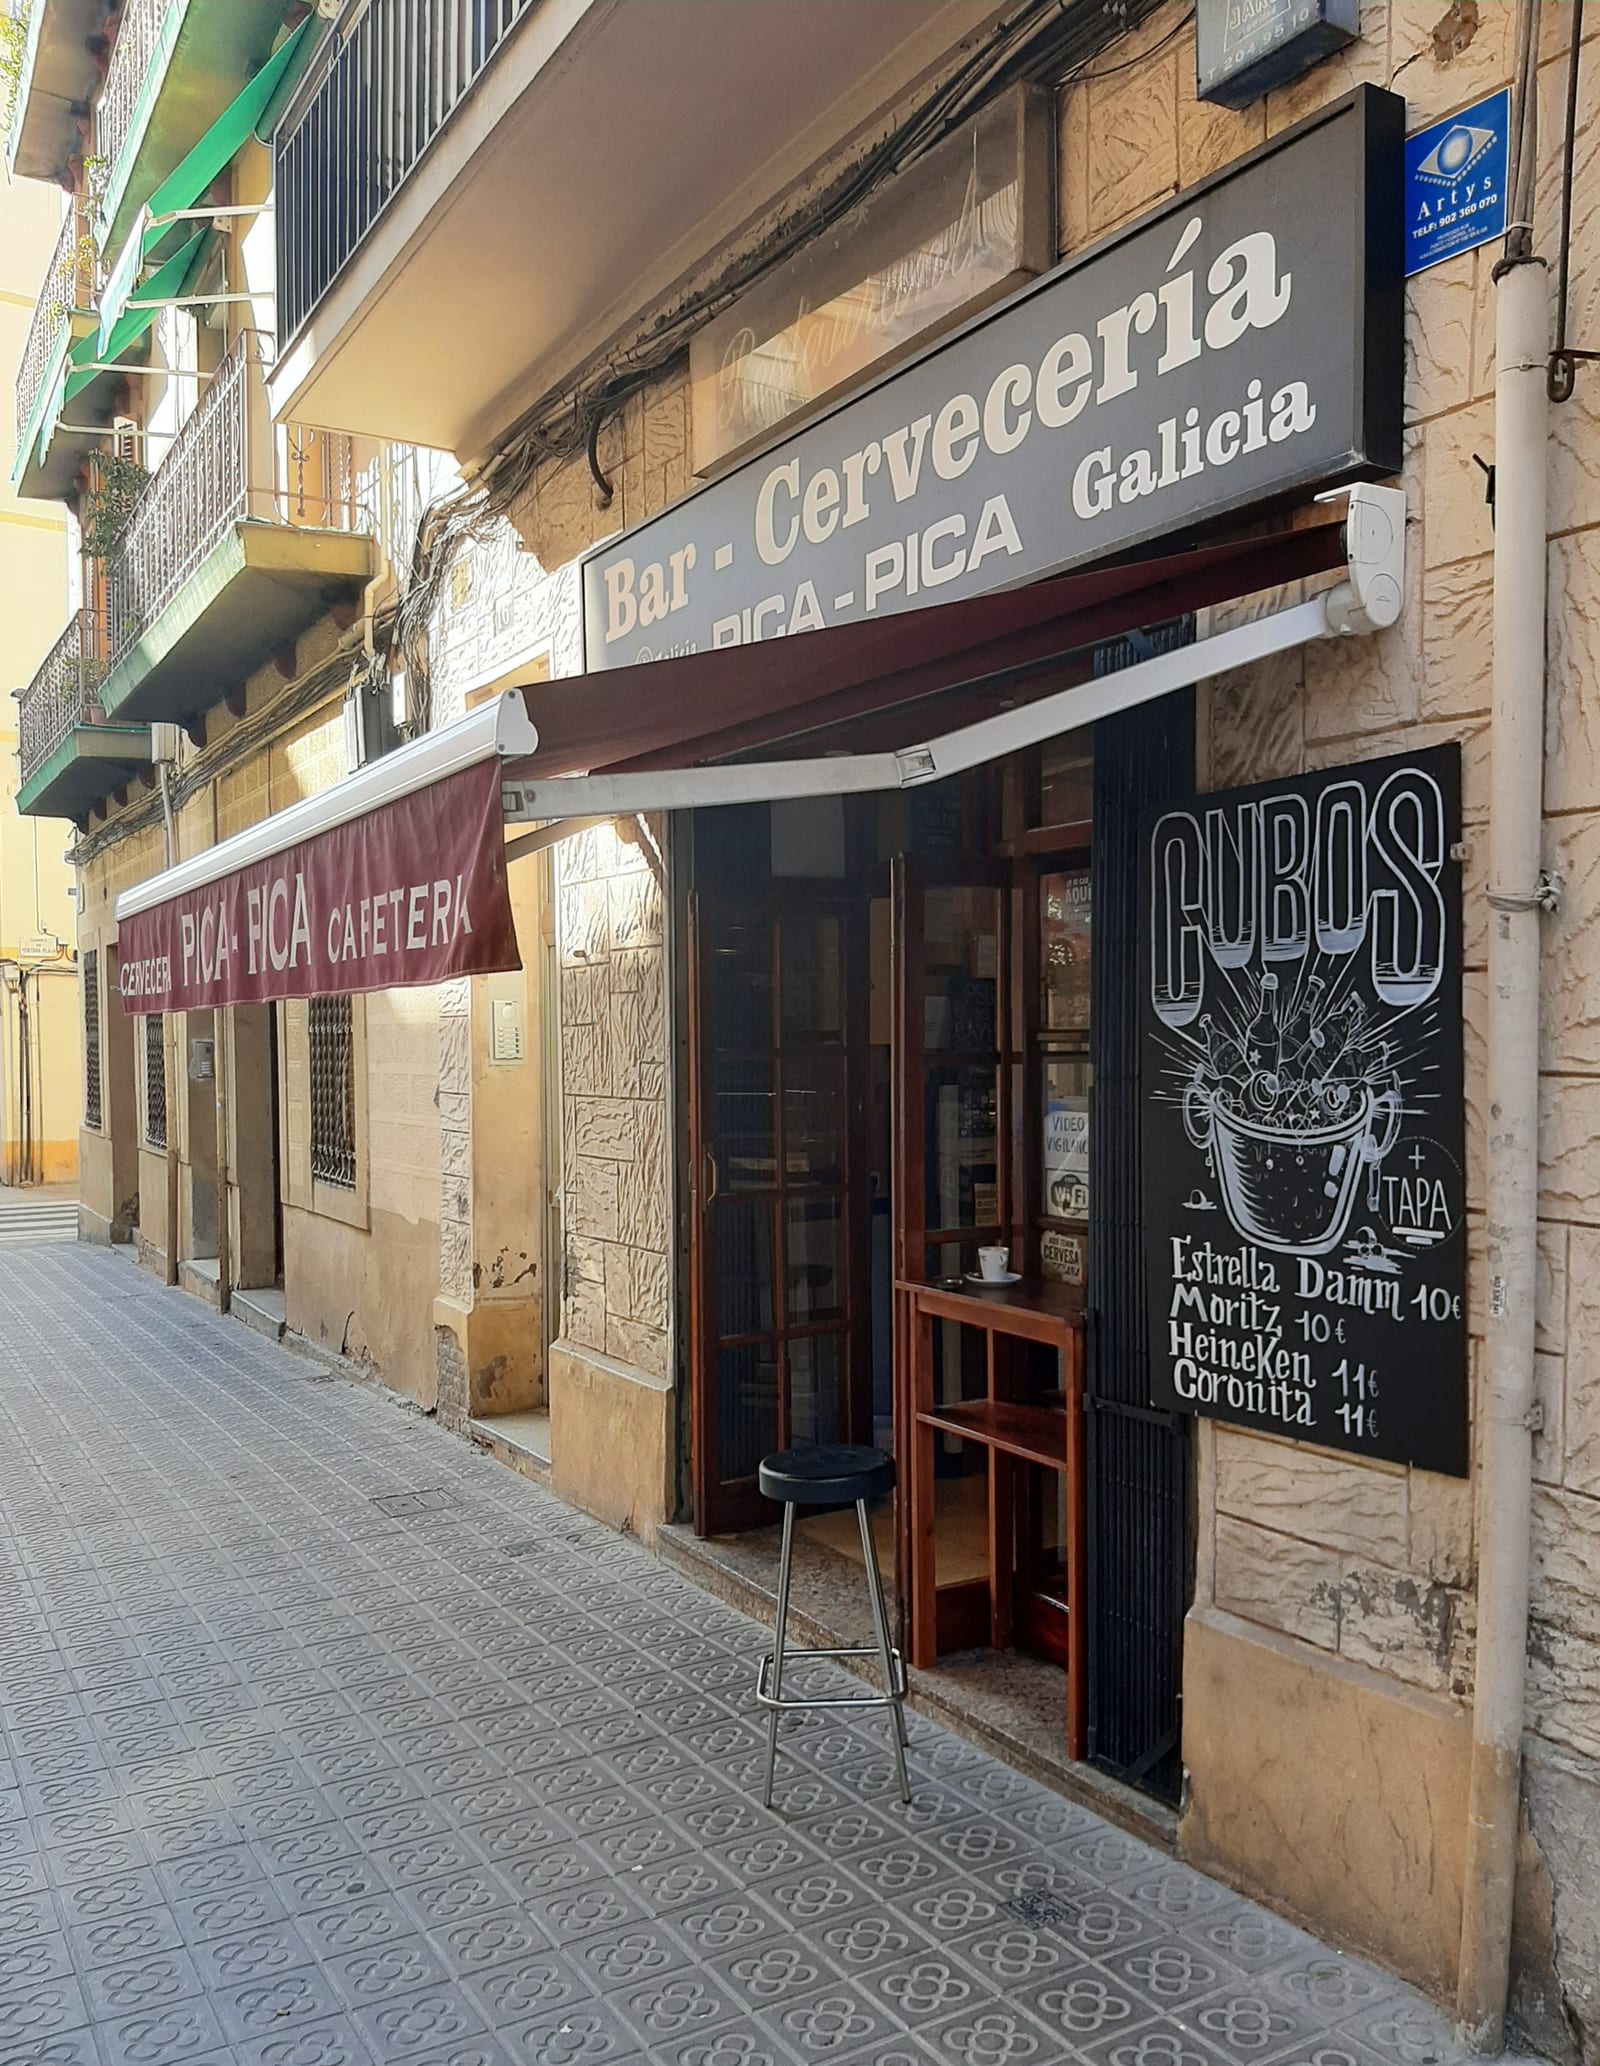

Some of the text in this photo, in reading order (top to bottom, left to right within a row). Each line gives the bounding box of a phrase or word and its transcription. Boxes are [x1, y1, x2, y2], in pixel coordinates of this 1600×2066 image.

[1263, 23, 1285, 45] 95
[1291, 7, 1310, 28] 10
[1417, 176, 1492, 221] Artys
[1439, 212, 1457, 227] 902
[1459, 202, 1477, 218] 360
[1478, 193, 1498, 209] 070
[604, 542, 697, 644] Bar
[754, 217, 1292, 566] Cervecería
[1072, 378, 1317, 520] Galicia
[712, 580, 826, 649] PICA
[866, 494, 1024, 613] PICA
[1151, 768, 1446, 1027] CUBOS
[181, 901, 229, 987] PICA
[247, 873, 311, 975] PICA
[1053, 1116, 1085, 1132] VIDEO
[1382, 1176, 1452, 1230] TAPA
[1044, 1244, 1079, 1264] CERVESA
[1169, 1235, 1281, 1294] Estrella
[1294, 1257, 1405, 1321] Damm
[1411, 1284, 1461, 1321] 10€
[1169, 1283, 1283, 1338] Moritz
[1173, 1358, 1380, 1438] Coronita 11€
[1331, 1359, 1380, 1400] 11€
